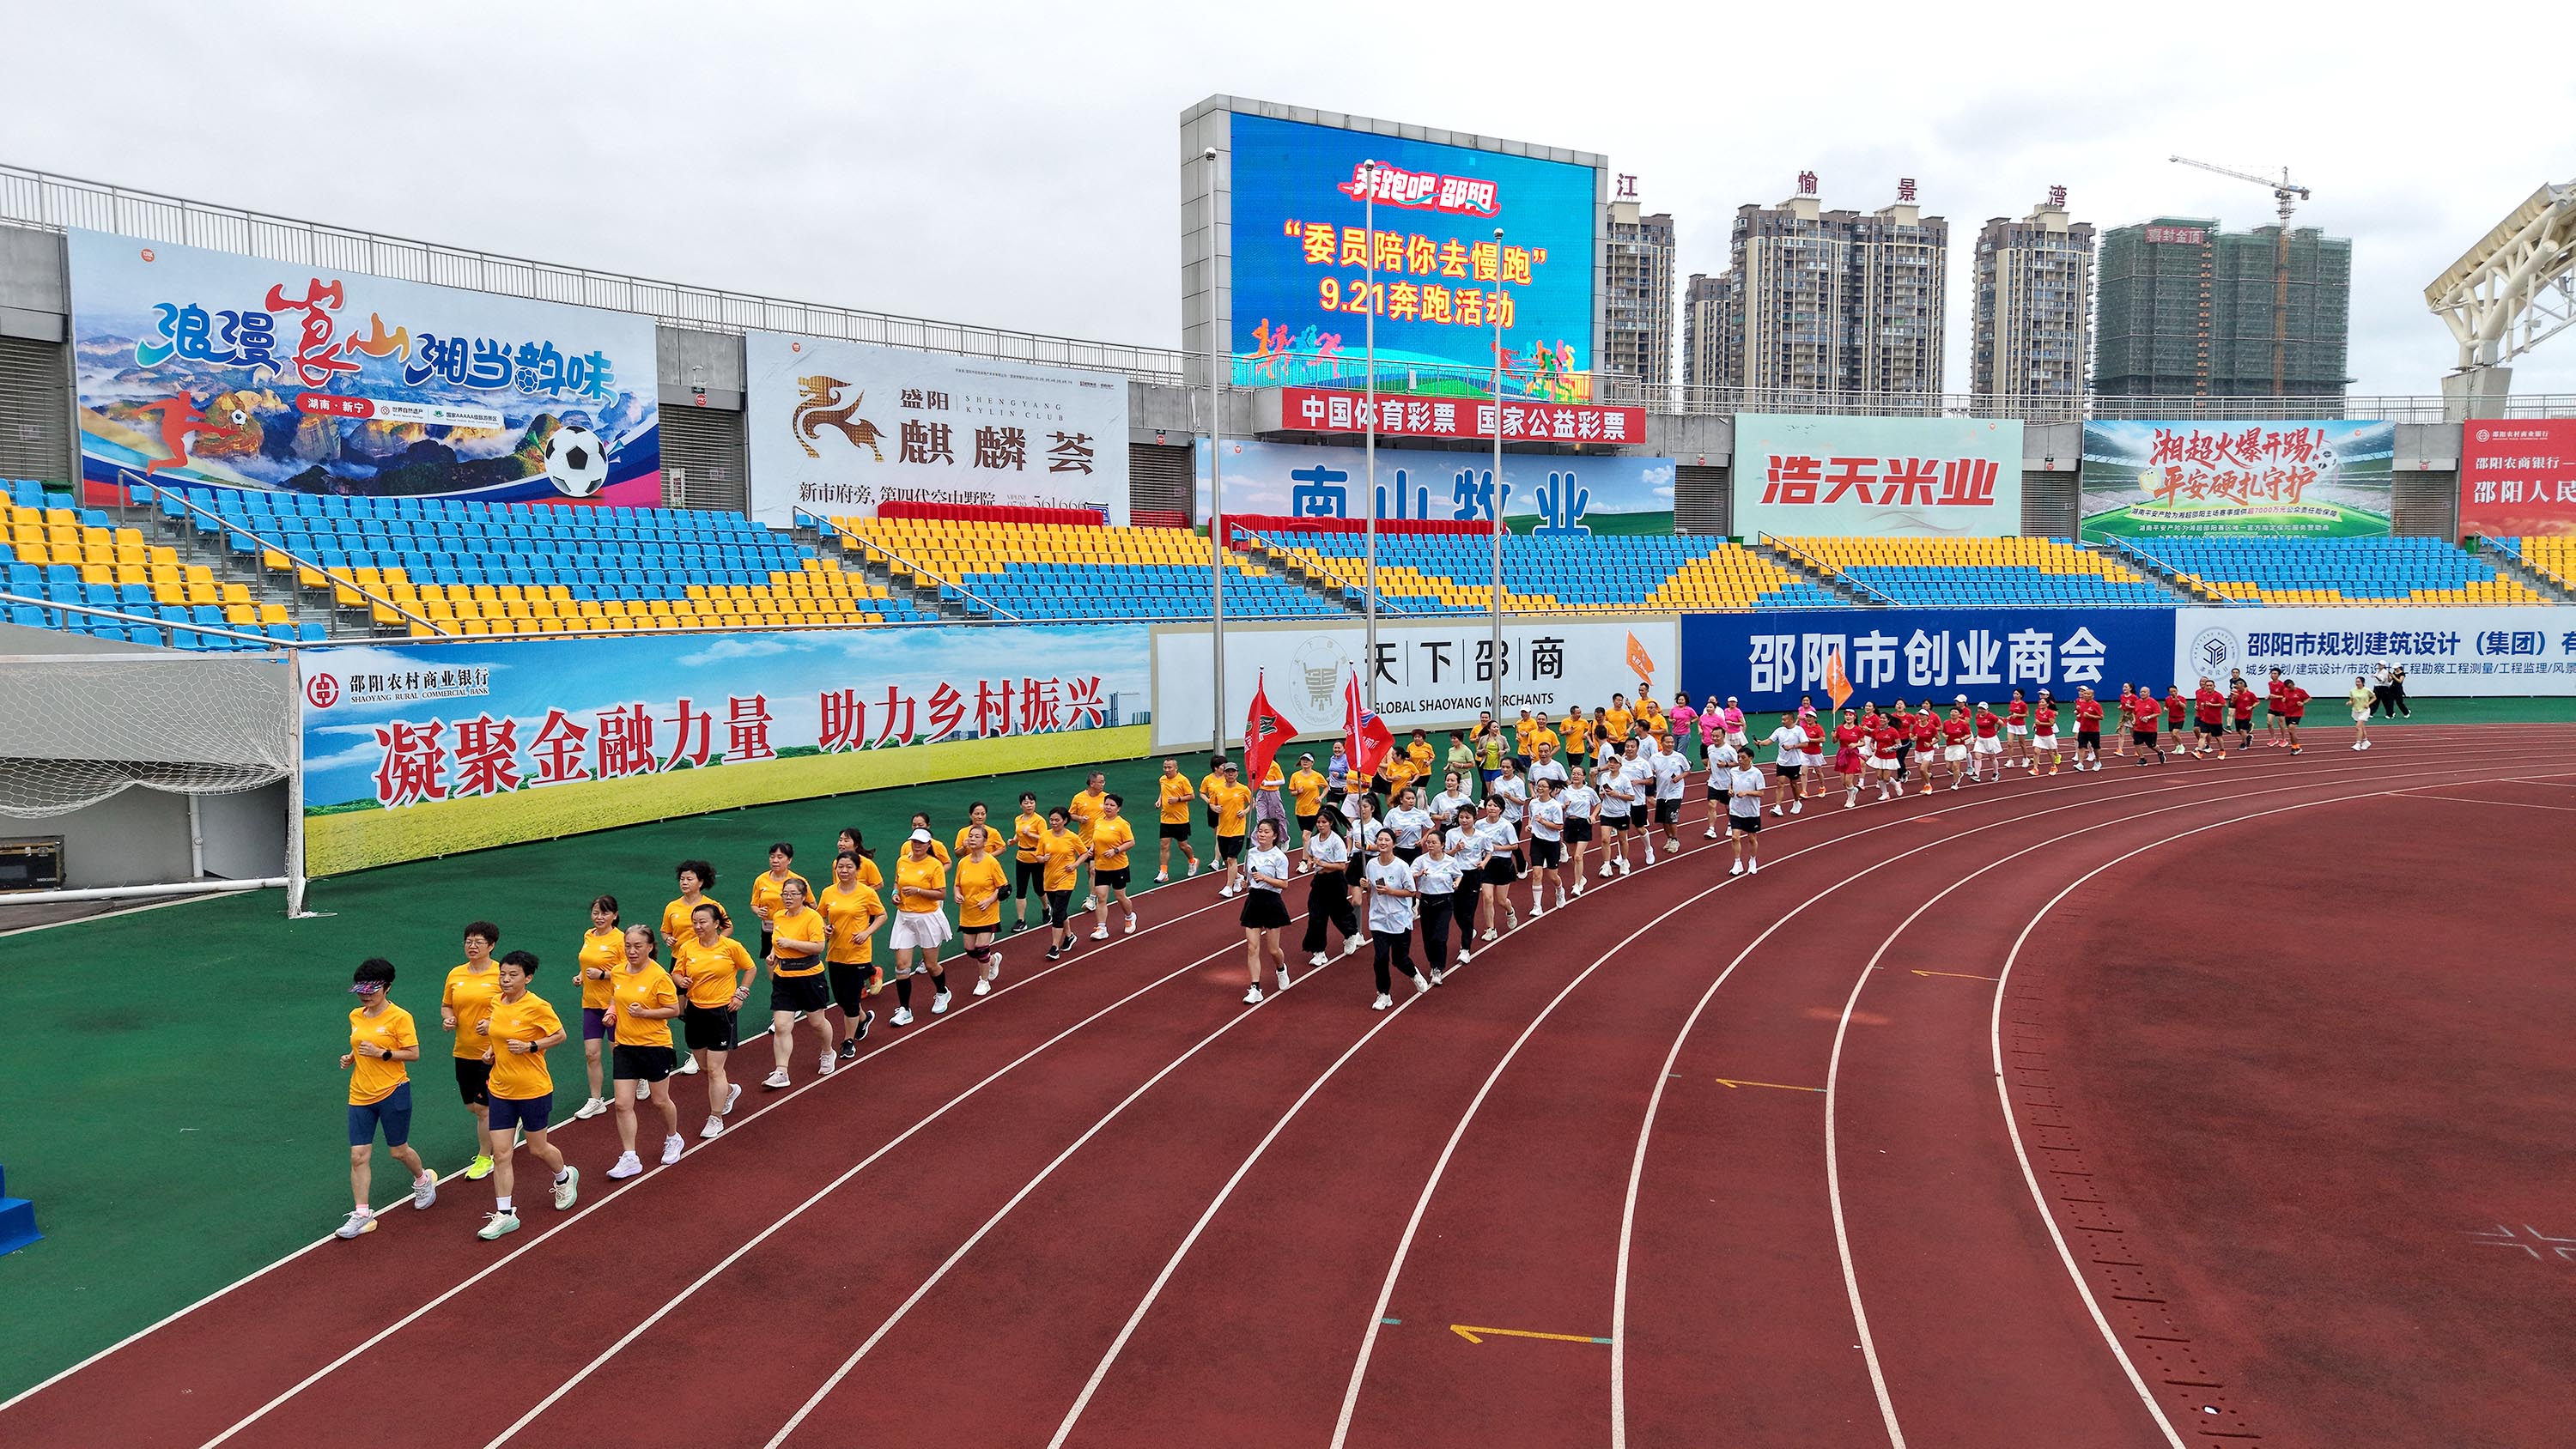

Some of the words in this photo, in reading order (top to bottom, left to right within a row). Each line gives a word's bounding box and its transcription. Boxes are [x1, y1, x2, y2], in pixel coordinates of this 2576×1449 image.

[1617, 173, 1637, 197] 江
[1798, 170, 1819, 195] 愉
[1898, 177, 1917, 202] 景
[2049, 185, 2068, 206] 湾
[1285, 221, 1547, 285] “委员陪你去慢跑”
[1320, 277, 1515, 328] 9.21奔跑活动
[900, 388, 950, 410] 盛阳
[965, 396, 1062, 410] SHENGYANG
[966, 406, 1015, 417] KYLIN
[1025, 411, 1064, 421] CLUB
[1302, 394, 1457, 433] 中国体育彩票
[1476, 403, 1626, 440] 国家公益彩票
[899, 418, 1095, 475] 麒麟荟
[1761, 455, 1999, 506] 浩天米业
[2154, 465, 2318, 509] 平安硬扎守护
[350, 668, 489, 694] 邵阳农村商业银行
[1749, 626, 2107, 693] 邵阳市创业商会
[350, 694, 392, 704] SHAOYANG
[395, 692, 419, 701] RURAL
[422, 689, 468, 699] COMMERCIAL
[470, 688, 489, 696] BANK
[1374, 699, 1417, 715] GLOBAL
[1419, 695, 1482, 712] SHAOYANG
[1485, 692, 1554, 708] MRCHANTS
[375, 694, 778, 807] 凝聚金融力量
[817, 676, 1105, 754] 助力乡村振兴
